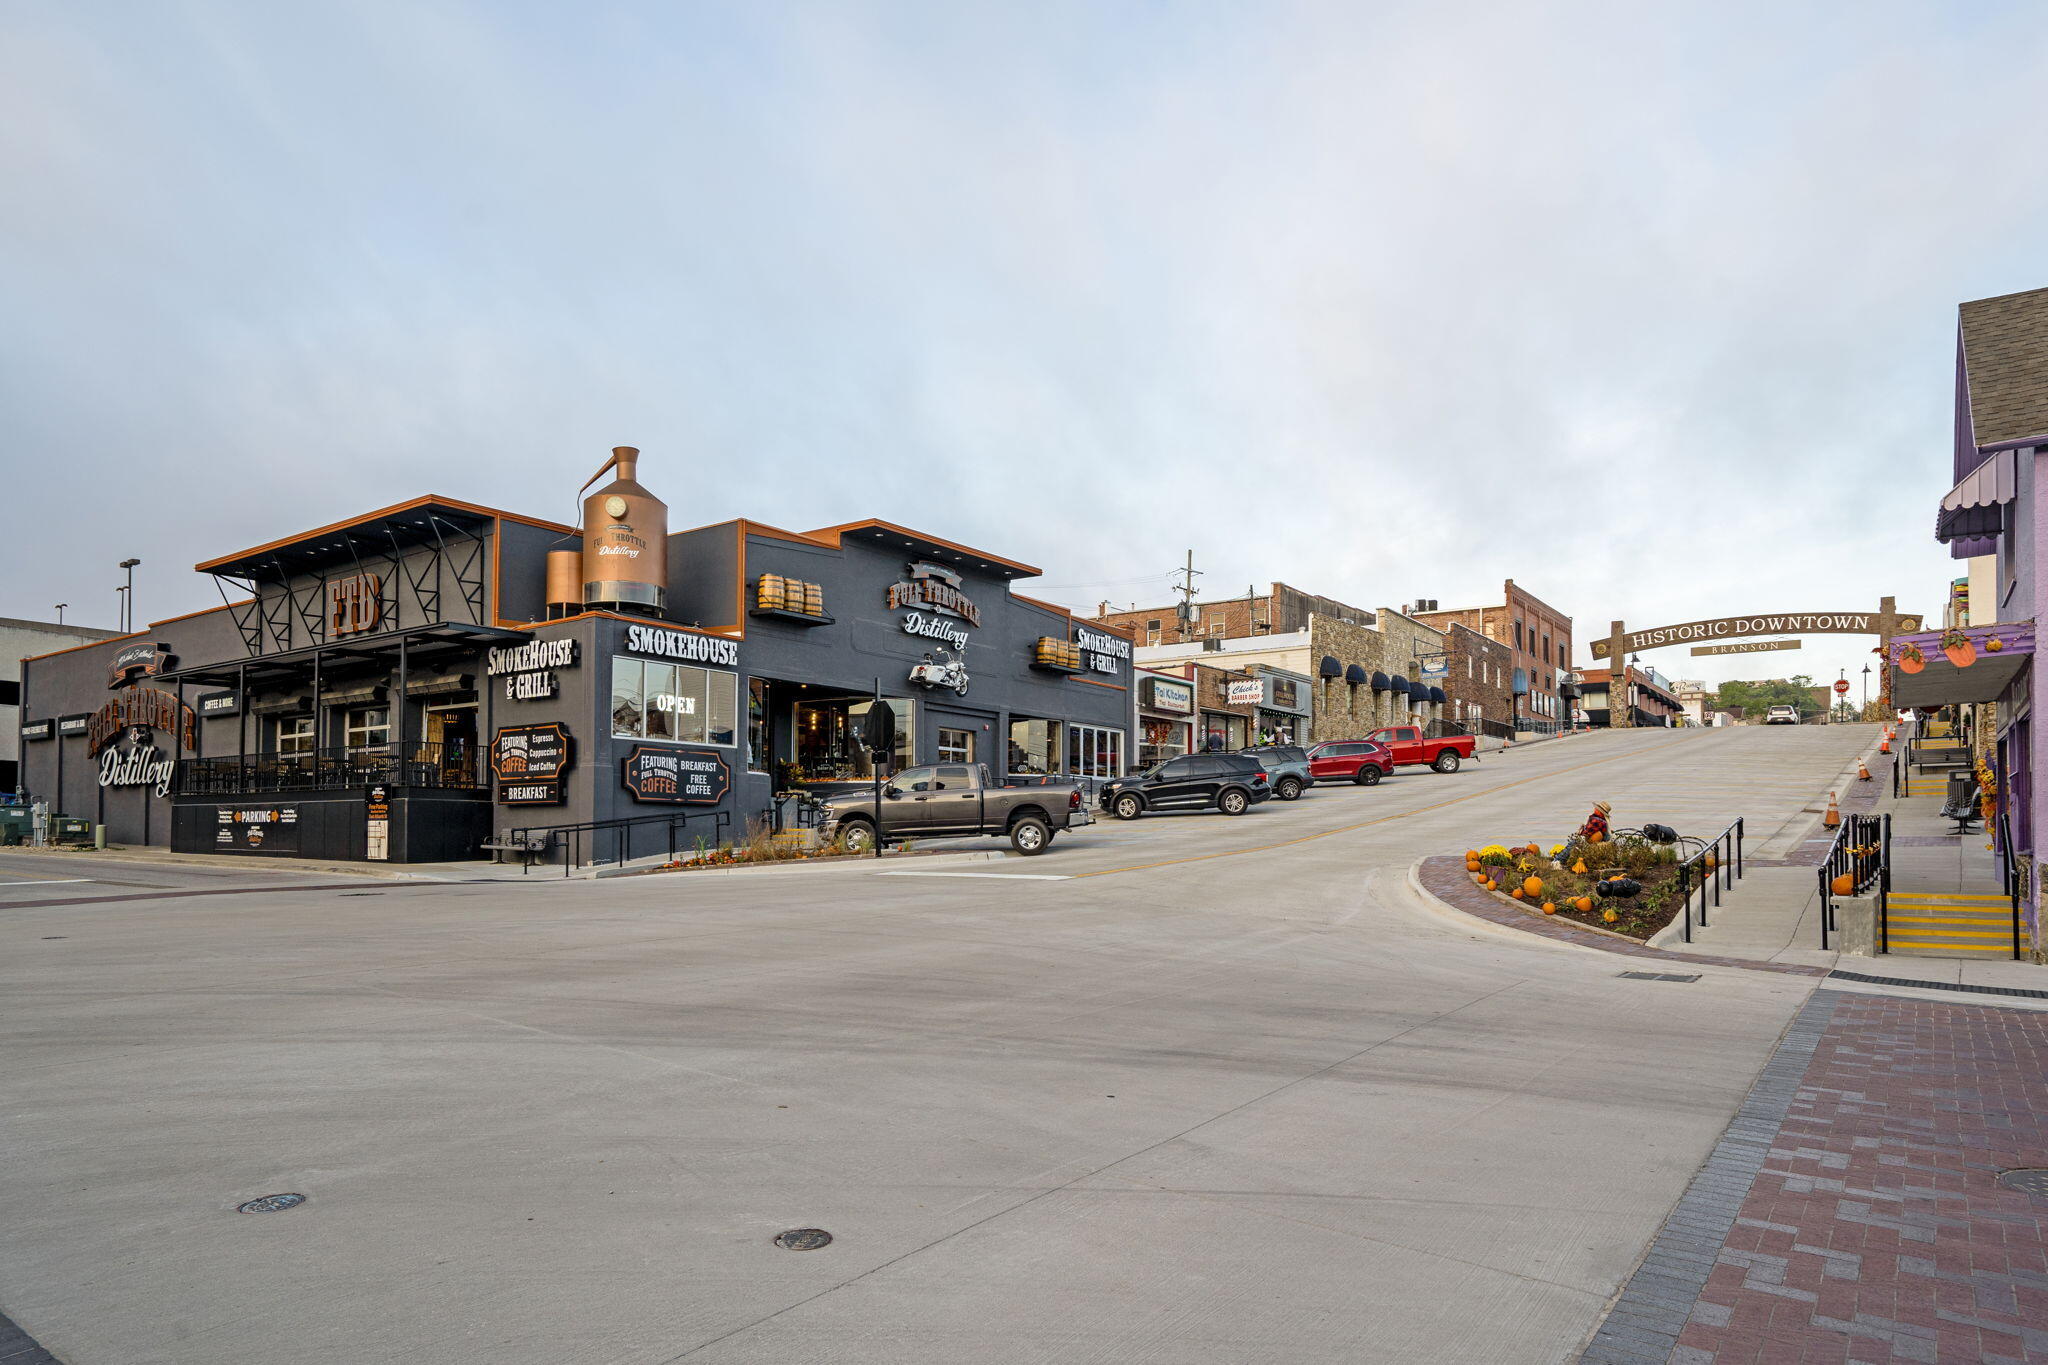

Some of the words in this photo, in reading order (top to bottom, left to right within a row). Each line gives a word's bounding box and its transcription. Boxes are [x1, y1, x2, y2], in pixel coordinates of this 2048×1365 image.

[599, 545, 639, 558] Distillery
[327, 573, 380, 637] FTD
[889, 582, 921, 610] FULL
[922, 579, 981, 629] THROTTLE
[905, 612, 968, 650] Distillery
[1632, 621, 1728, 648] HISTORIC
[1734, 615, 1869, 633] DOWNTOWN
[627, 625, 737, 666] SMOKEHOUSE
[1712, 642, 1779, 654] BRANSON
[1090, 653, 1096, 669] &
[1096, 654, 1118, 674] GRILL
[506, 676, 515, 700] &
[516, 671, 551, 699] GRILL
[1232, 683, 1258, 694] Chick's
[1165, 688, 1188, 701] Kitchen
[204, 699, 218, 710] COFFEE
[656, 694, 696, 715] OPEN
[501, 735, 528, 752] FEATURING
[532, 734, 554, 744] Espresso
[529, 748, 557, 759] Cappuccino
[99, 744, 175, 798] Distillery
[501, 757, 527, 773] COFFEE
[528, 763, 539, 772] Iced
[540, 762, 556, 771] Coffee
[641, 755, 678, 773] FEATURING
[680, 760, 717, 772] BREAKFAST
[641, 770, 652, 780] FULL
[654, 768, 678, 782] THROTTLE
[690, 774, 707, 785] FREE
[641, 777, 678, 794] COFFEE
[686, 784, 711, 795] COFFEE
[508, 786, 548, 800] BREAKFAST
[241, 810, 271, 823] PARKING
